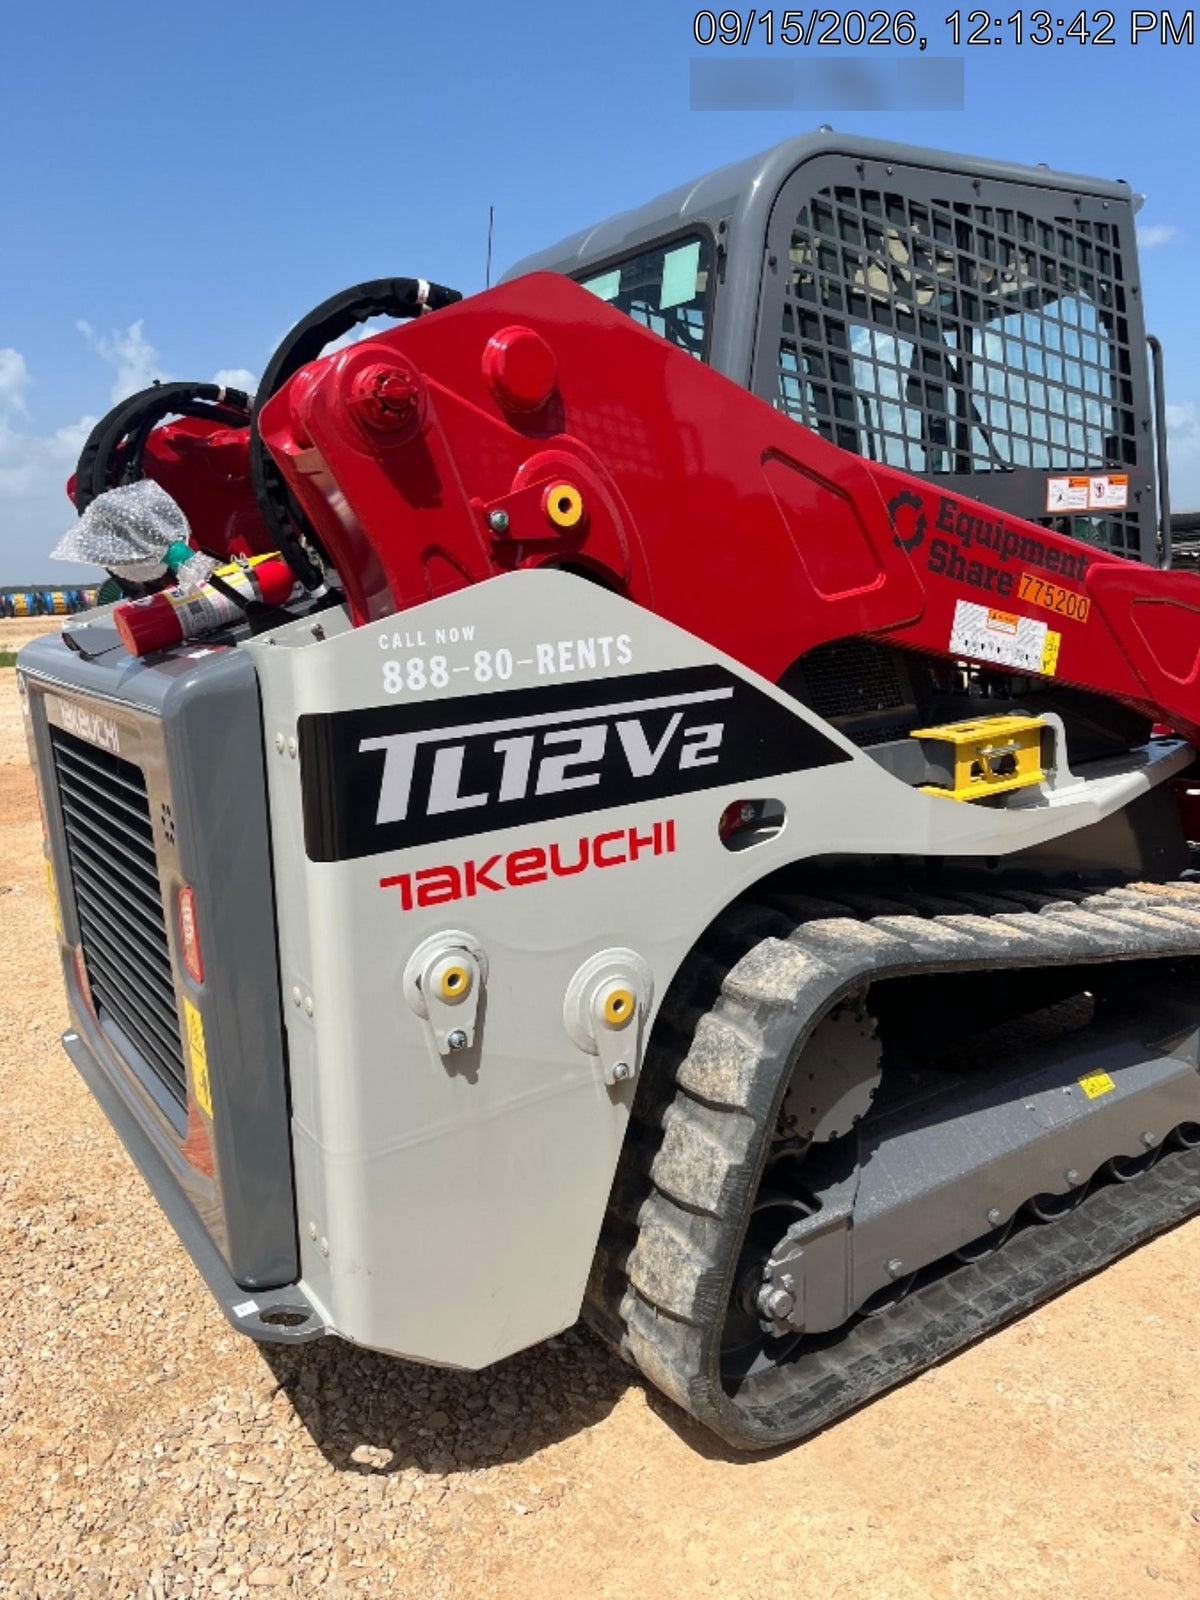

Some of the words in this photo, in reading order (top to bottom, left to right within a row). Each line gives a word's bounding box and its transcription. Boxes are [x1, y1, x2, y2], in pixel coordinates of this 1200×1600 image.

[927, 538, 1014, 597] Share
[935, 495, 1089, 582] Equipment
[1020, 574, 1089, 621] 775200
[378, 631, 427, 650] CALL
[435, 625, 476, 645] NOW
[382, 634, 633, 694] 888-80-RENTS
[358, 686, 735, 826] TL12V2
[379, 819, 677, 912] TAKEUCHI
